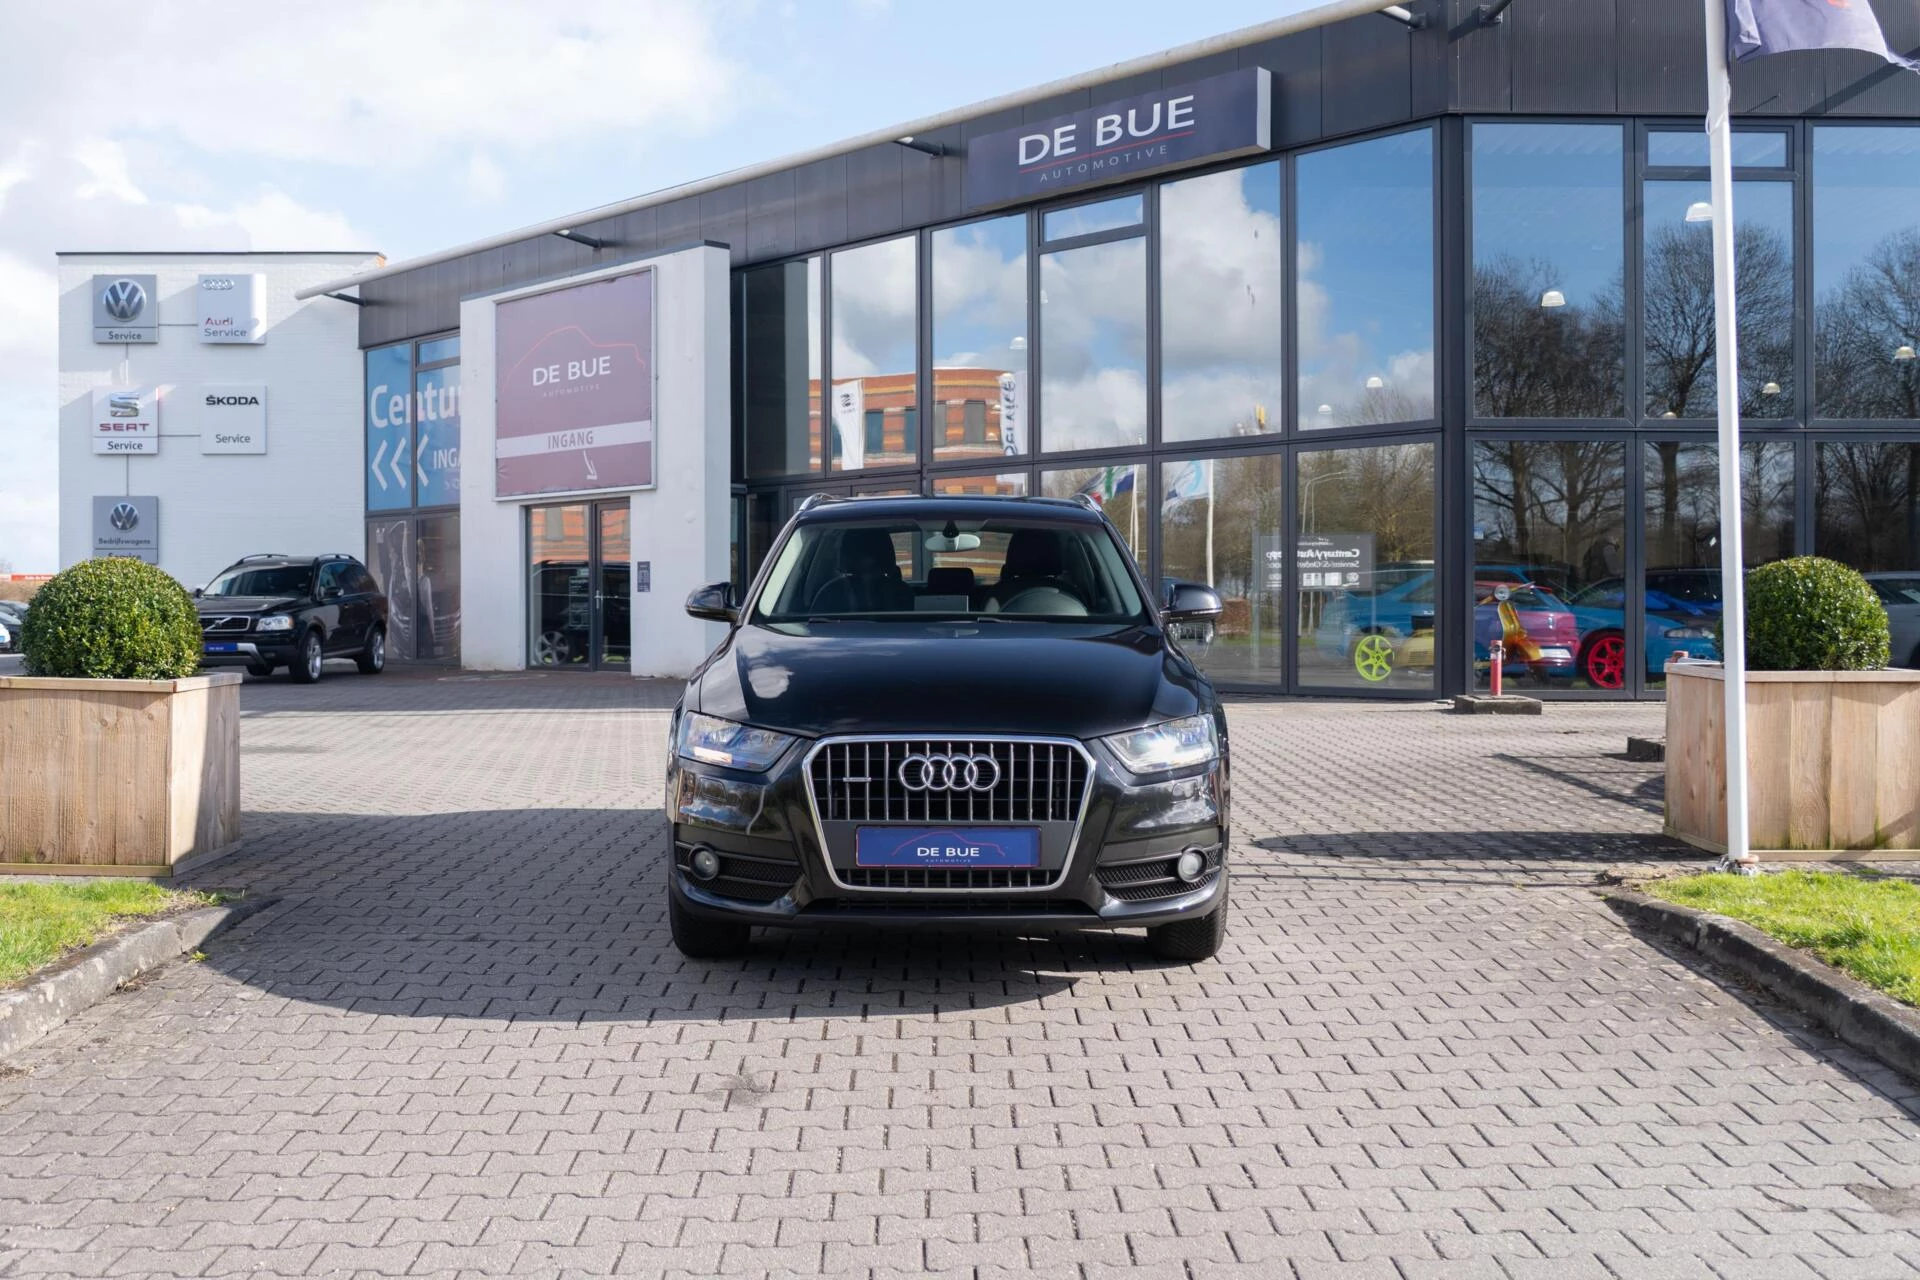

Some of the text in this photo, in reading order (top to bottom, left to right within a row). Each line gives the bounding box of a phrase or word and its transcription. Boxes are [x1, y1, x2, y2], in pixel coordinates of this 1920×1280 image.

[1018, 95, 1195, 166] DE BUE
[1040, 144, 1168, 182] AUTOMOTIVE
[205, 317, 233, 326] Audi
[107, 331, 142, 340] Service
[204, 328, 248, 337] Service
[532, 355, 612, 387] DE BUE
[205, 394, 260, 406] ŠKODA
[99, 423, 150, 432] SEAT
[215, 433, 251, 444] Service
[547, 430, 594, 450] INGANG
[107, 440, 143, 450] Service
[917, 847, 980, 857] DE BUE
